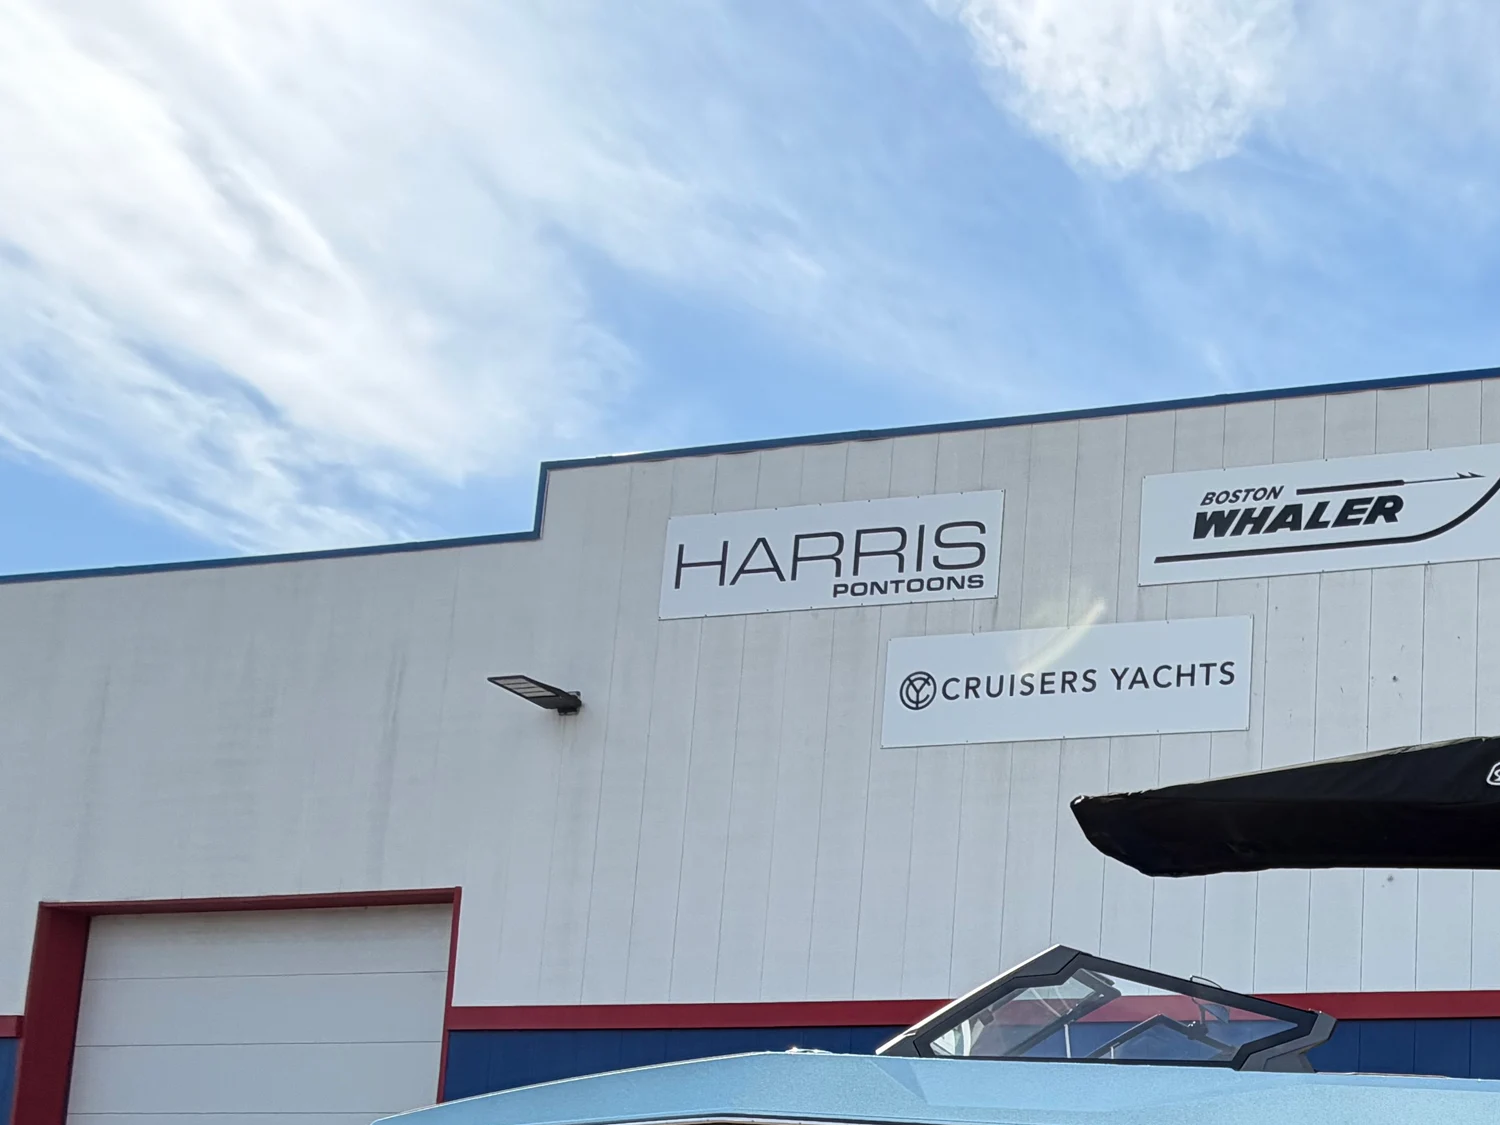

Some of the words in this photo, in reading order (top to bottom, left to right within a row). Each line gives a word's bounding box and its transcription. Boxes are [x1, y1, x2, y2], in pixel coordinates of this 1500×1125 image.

[1200, 485, 1285, 506] BOSTON
[1192, 494, 1405, 541] WHALER
[674, 520, 986, 590] HARRIS
[832, 574, 985, 598] PONTOONS
[941, 668, 1097, 701] CRUISERS
[1110, 661, 1235, 691] YACHTS
